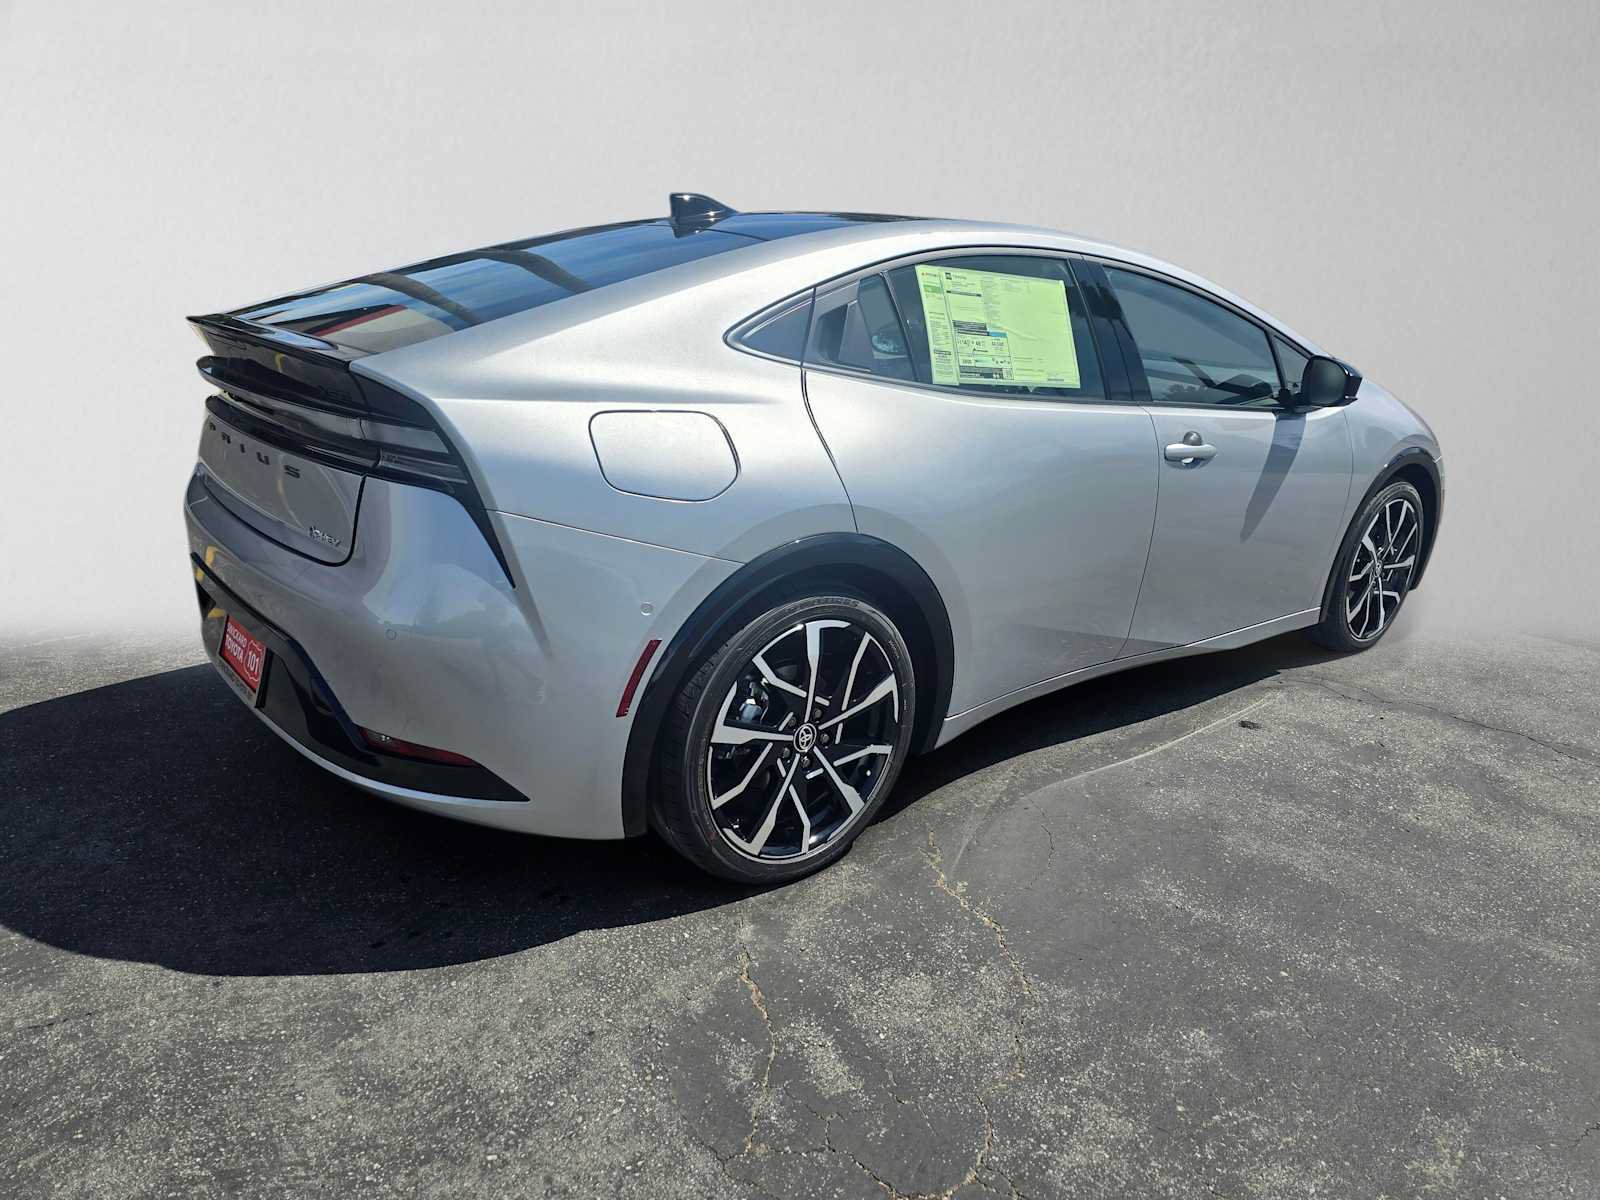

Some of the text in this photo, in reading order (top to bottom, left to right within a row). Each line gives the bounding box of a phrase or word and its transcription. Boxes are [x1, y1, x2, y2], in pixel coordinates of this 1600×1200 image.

[209, 422, 300, 479] PRIUS
[225, 633, 244, 663] TOYOTA
[247, 650, 260, 675] 101
